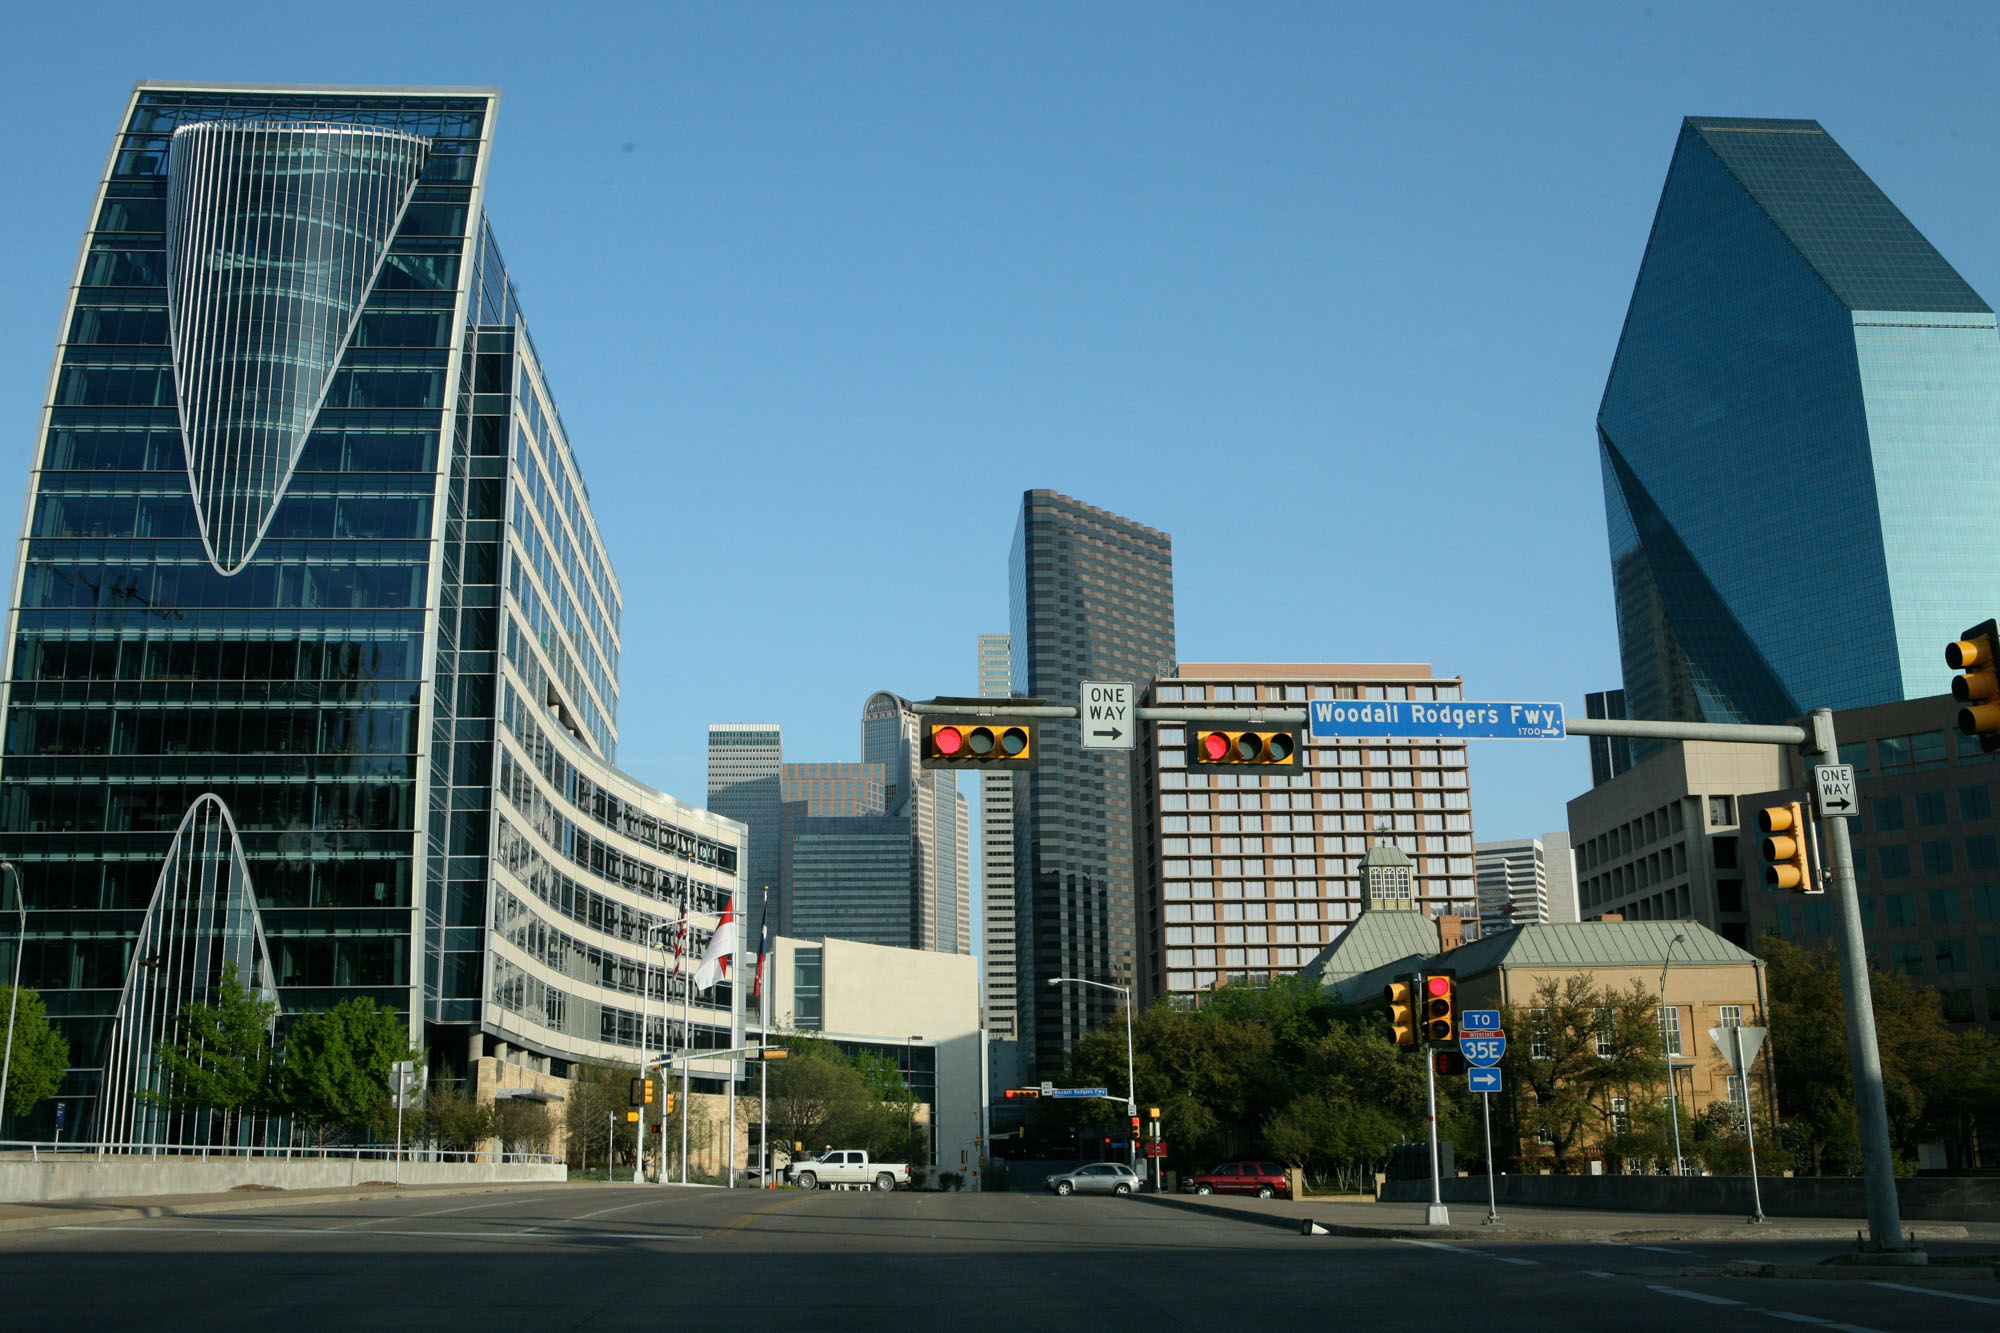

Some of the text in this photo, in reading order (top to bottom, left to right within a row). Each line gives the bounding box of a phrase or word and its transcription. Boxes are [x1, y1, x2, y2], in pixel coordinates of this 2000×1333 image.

[1091, 688, 1125, 702] ONE
[1089, 706, 1126, 720] WAY
[1315, 703, 1399, 723] Woodall
[1411, 704, 1499, 730] Rodgers
[1518, 727, 1541, 736] 1700
[1822, 770, 1849, 782] ONE
[1823, 784, 1850, 795] WAY
[1472, 1014, 1490, 1025] TO
[1465, 1041, 1500, 1059] 35E
